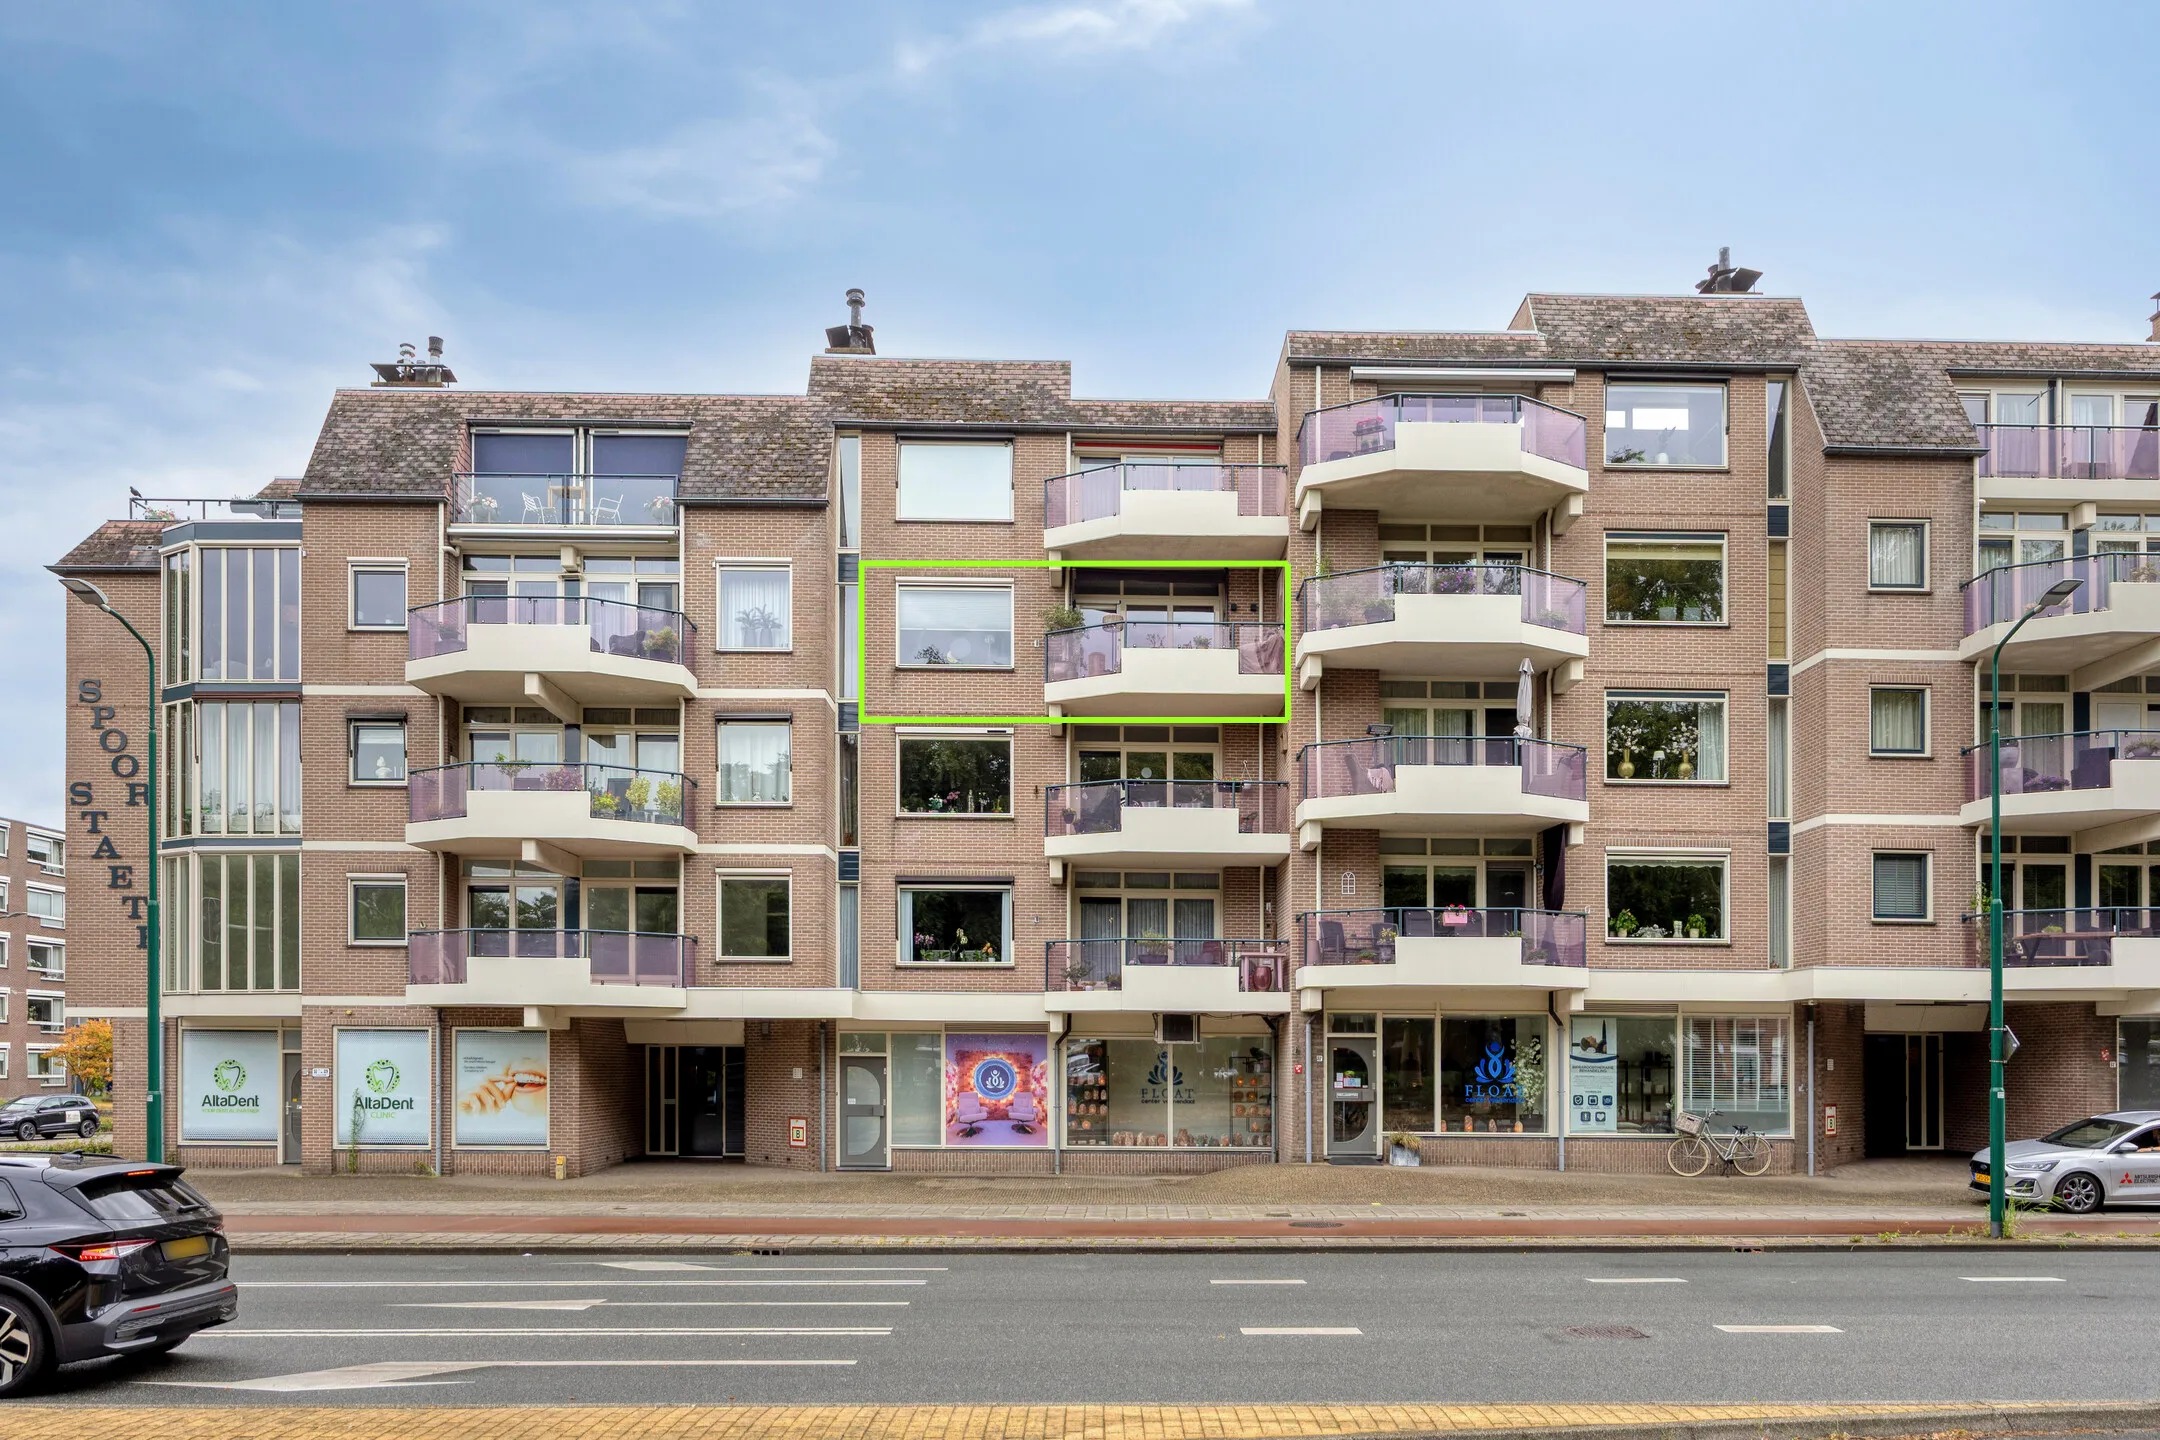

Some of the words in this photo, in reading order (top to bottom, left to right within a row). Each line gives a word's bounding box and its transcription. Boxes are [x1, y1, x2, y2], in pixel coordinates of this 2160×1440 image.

[79, 679, 149, 806] SPOOR
[201, 1094, 260, 1107] AltaDent
[354, 1096, 415, 1110] AltaDent
[370, 1111, 396, 1119] CLINIC
